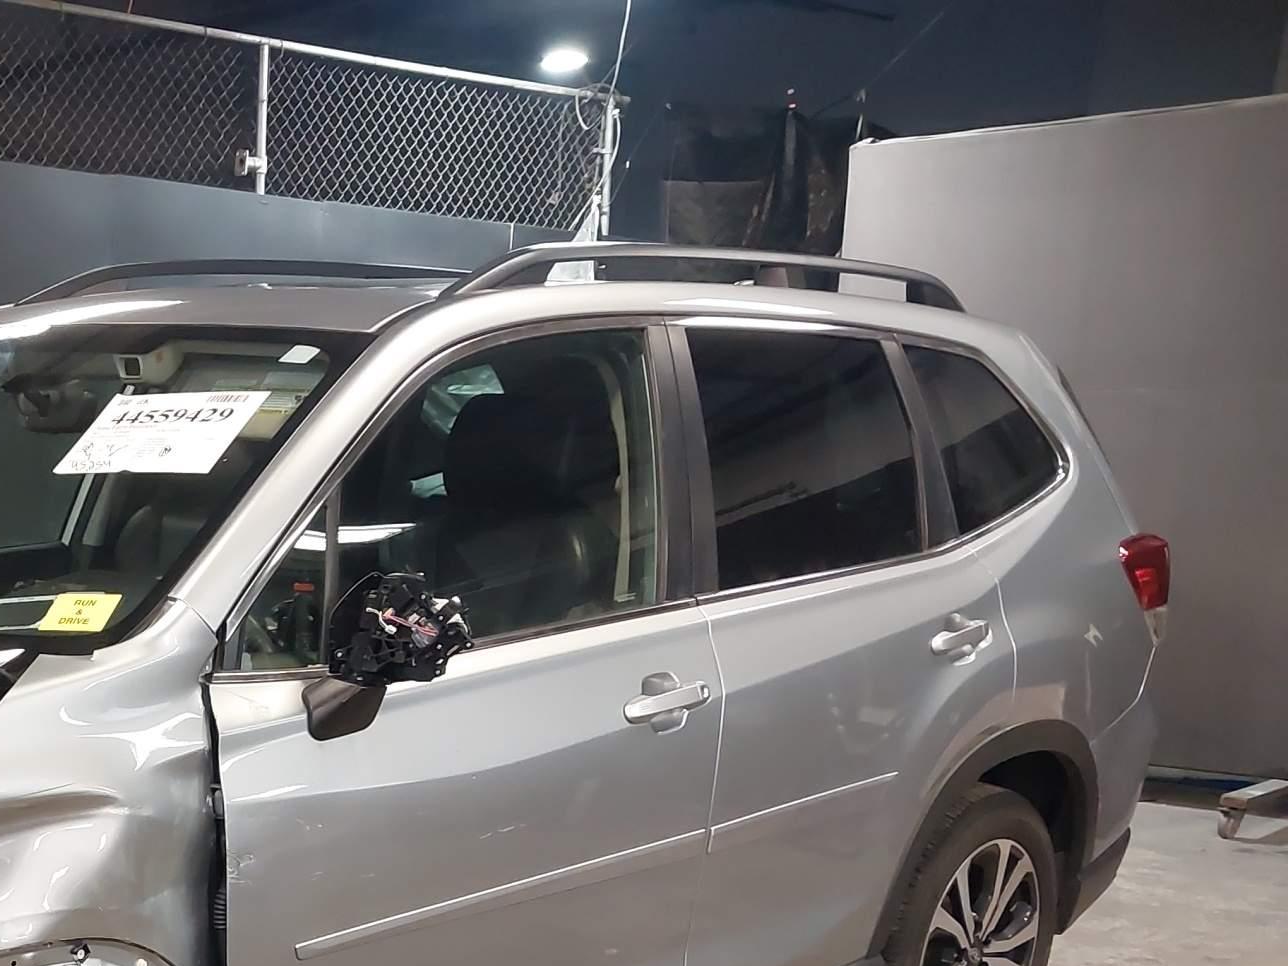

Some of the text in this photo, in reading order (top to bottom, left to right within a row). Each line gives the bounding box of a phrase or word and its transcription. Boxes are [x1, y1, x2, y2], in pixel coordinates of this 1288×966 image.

[112, 408, 235, 425] 44559429
[73, 599, 98, 607] RUN
[57, 617, 90, 625] DRIVE
